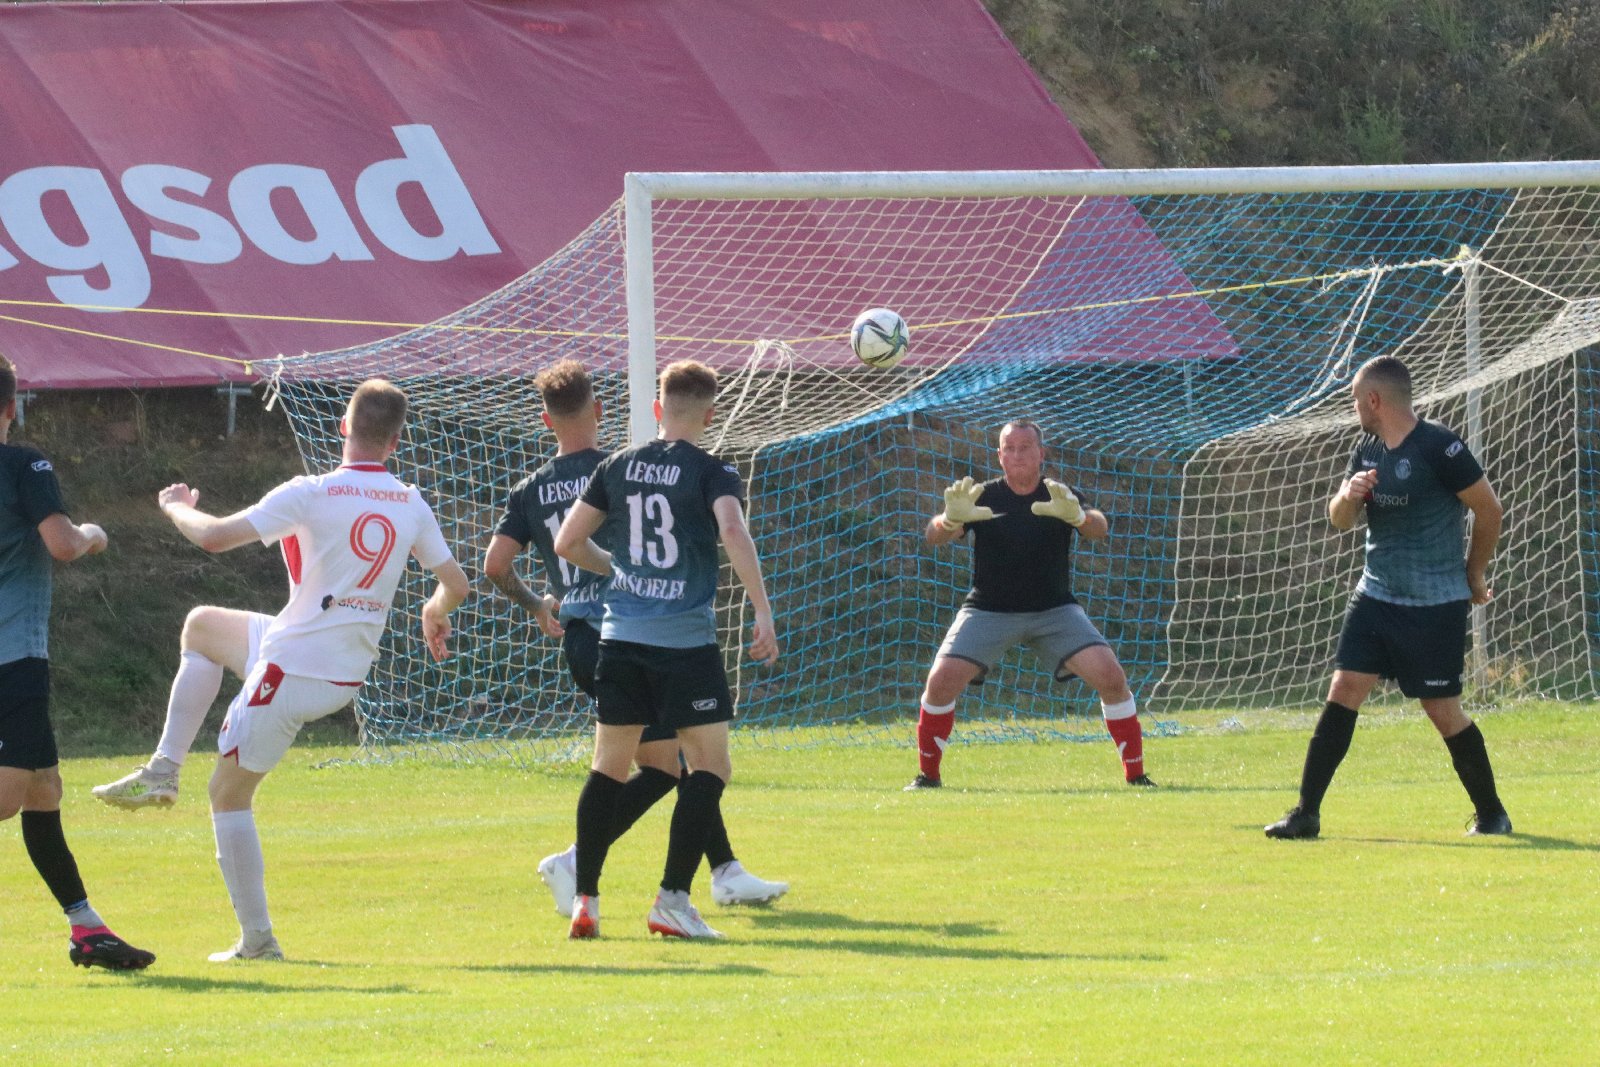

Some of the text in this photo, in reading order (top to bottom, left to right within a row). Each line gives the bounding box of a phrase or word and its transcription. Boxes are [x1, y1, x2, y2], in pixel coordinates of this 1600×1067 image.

[0, 124, 502, 312] gsad
[327, 485, 361, 497] ISKRA
[625, 460, 681, 486] LEGSAD
[350, 511, 397, 589] 9
[626, 491, 679, 569] 13
